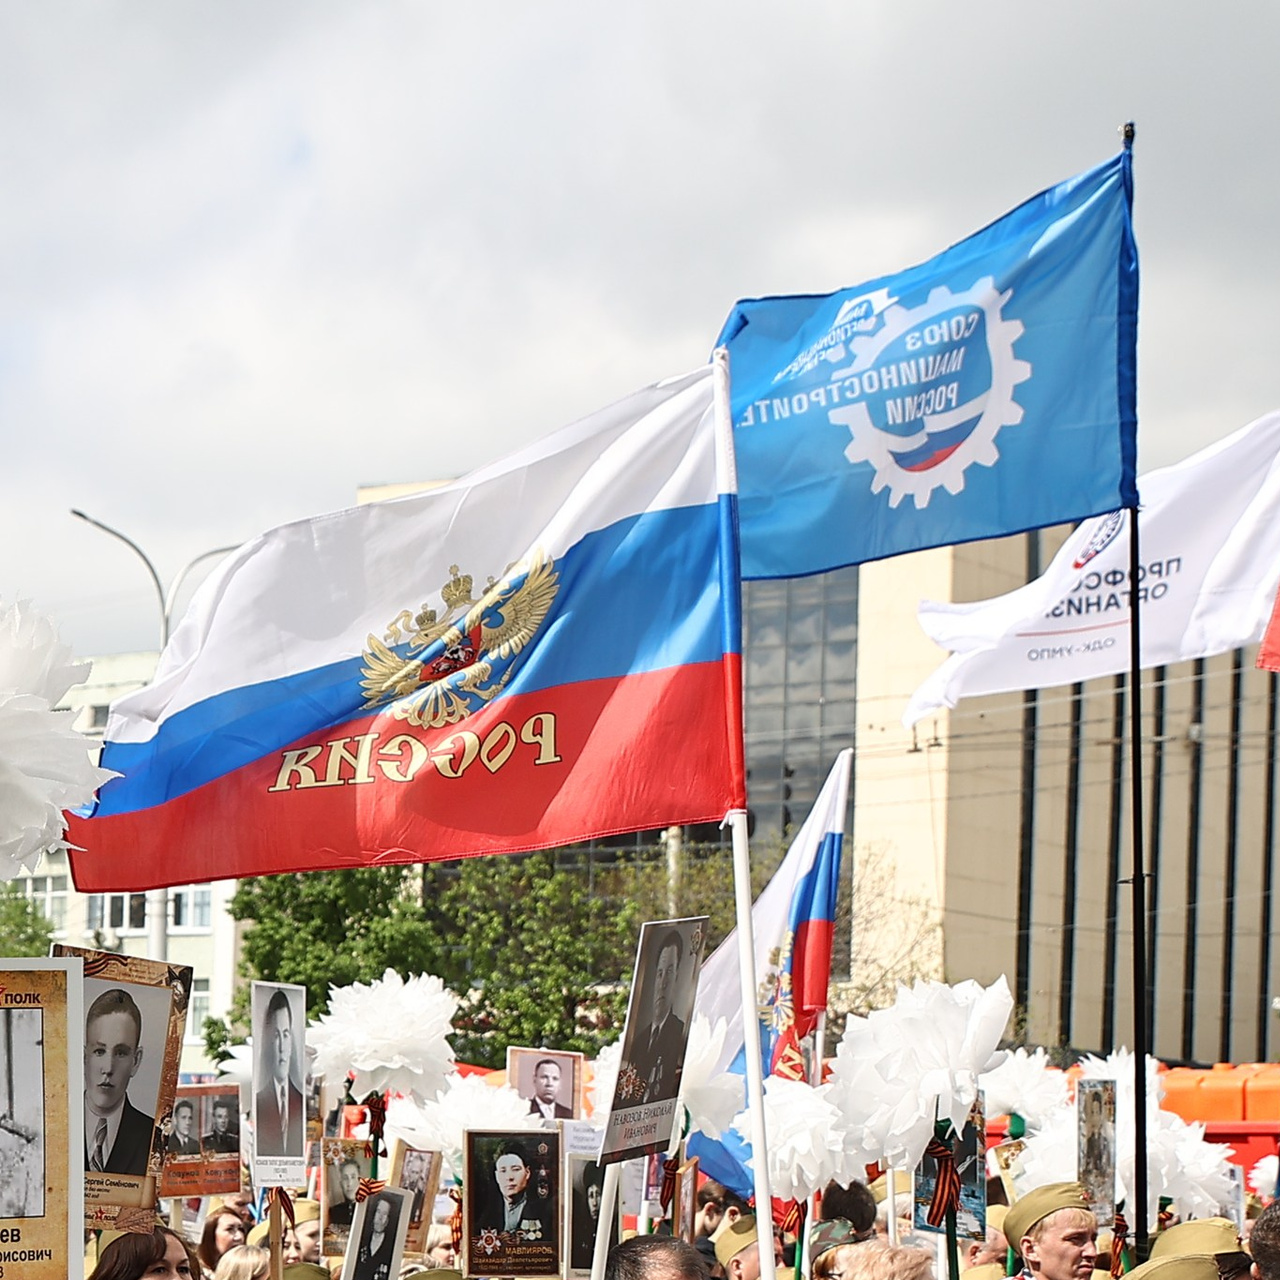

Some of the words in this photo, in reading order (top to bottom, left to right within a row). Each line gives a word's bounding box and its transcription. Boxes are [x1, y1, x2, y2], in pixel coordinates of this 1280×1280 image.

[5, 993, 41, 1004] ПОЛК
[623, 1123, 657, 1139] ИВАНОВИЧ
[506, 1246, 553, 1255] МАВЛИЯРОВ
